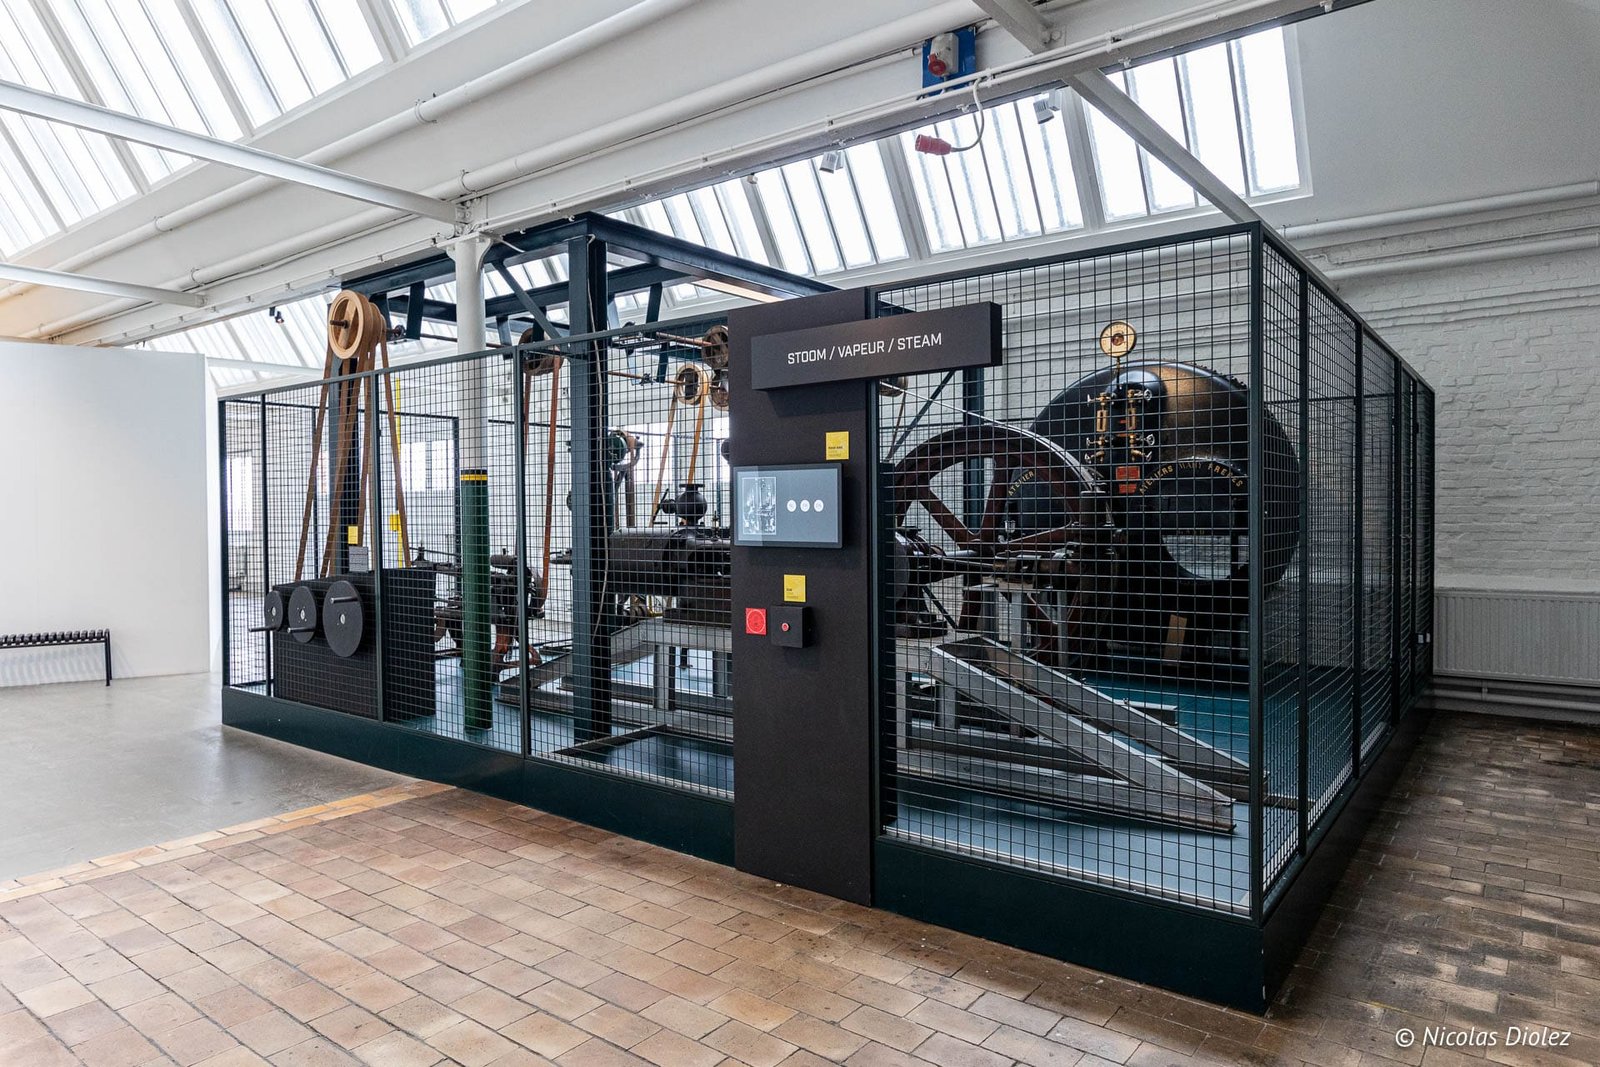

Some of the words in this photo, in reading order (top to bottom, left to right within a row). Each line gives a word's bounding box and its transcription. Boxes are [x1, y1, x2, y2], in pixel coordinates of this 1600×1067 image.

[787, 348, 827, 365] STOOM
[829, 346, 836, 361] /
[838, 340, 885, 359] VAPEUR
[888, 338, 895, 353] /
[897, 332, 942, 351] STEAM
